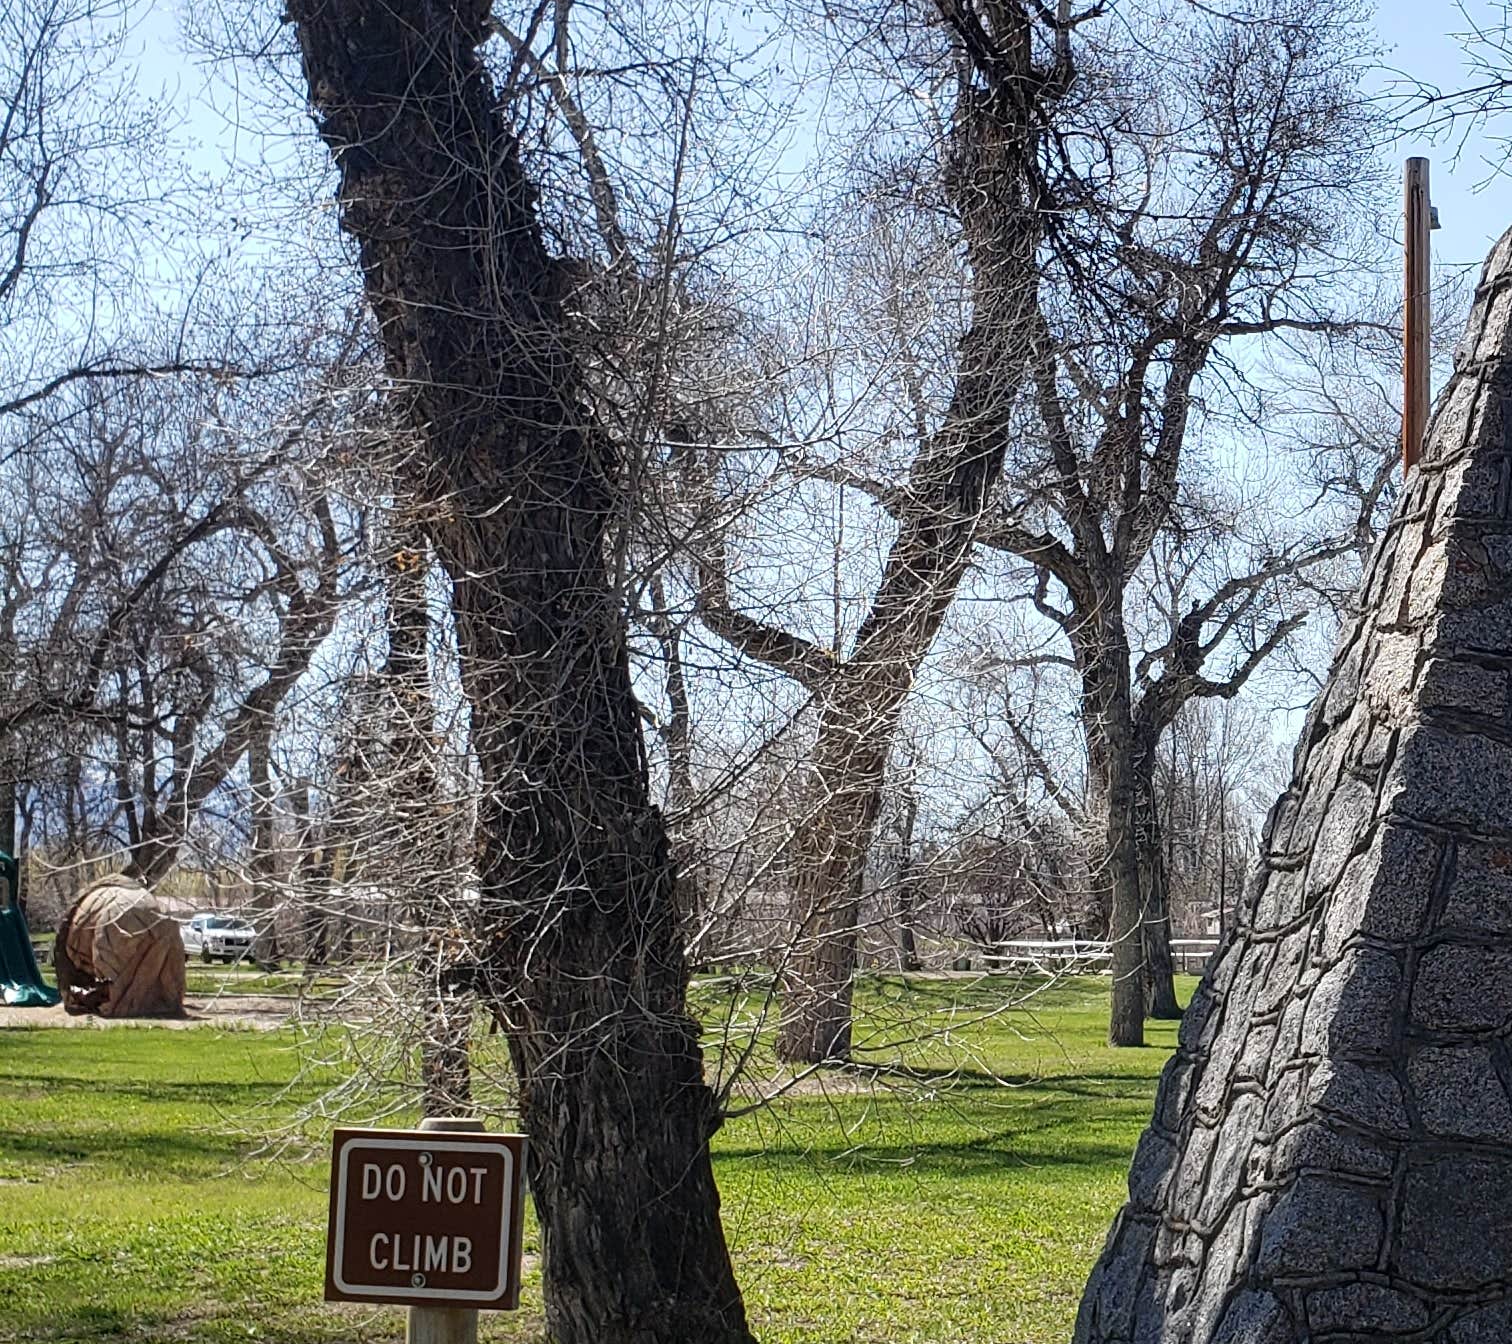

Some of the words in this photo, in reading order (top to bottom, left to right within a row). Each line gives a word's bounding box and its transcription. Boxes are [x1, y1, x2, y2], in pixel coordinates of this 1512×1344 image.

[362, 1163, 406, 1202] DO
[421, 1165, 488, 1205] NOT
[369, 1232, 473, 1274] CLIMB
